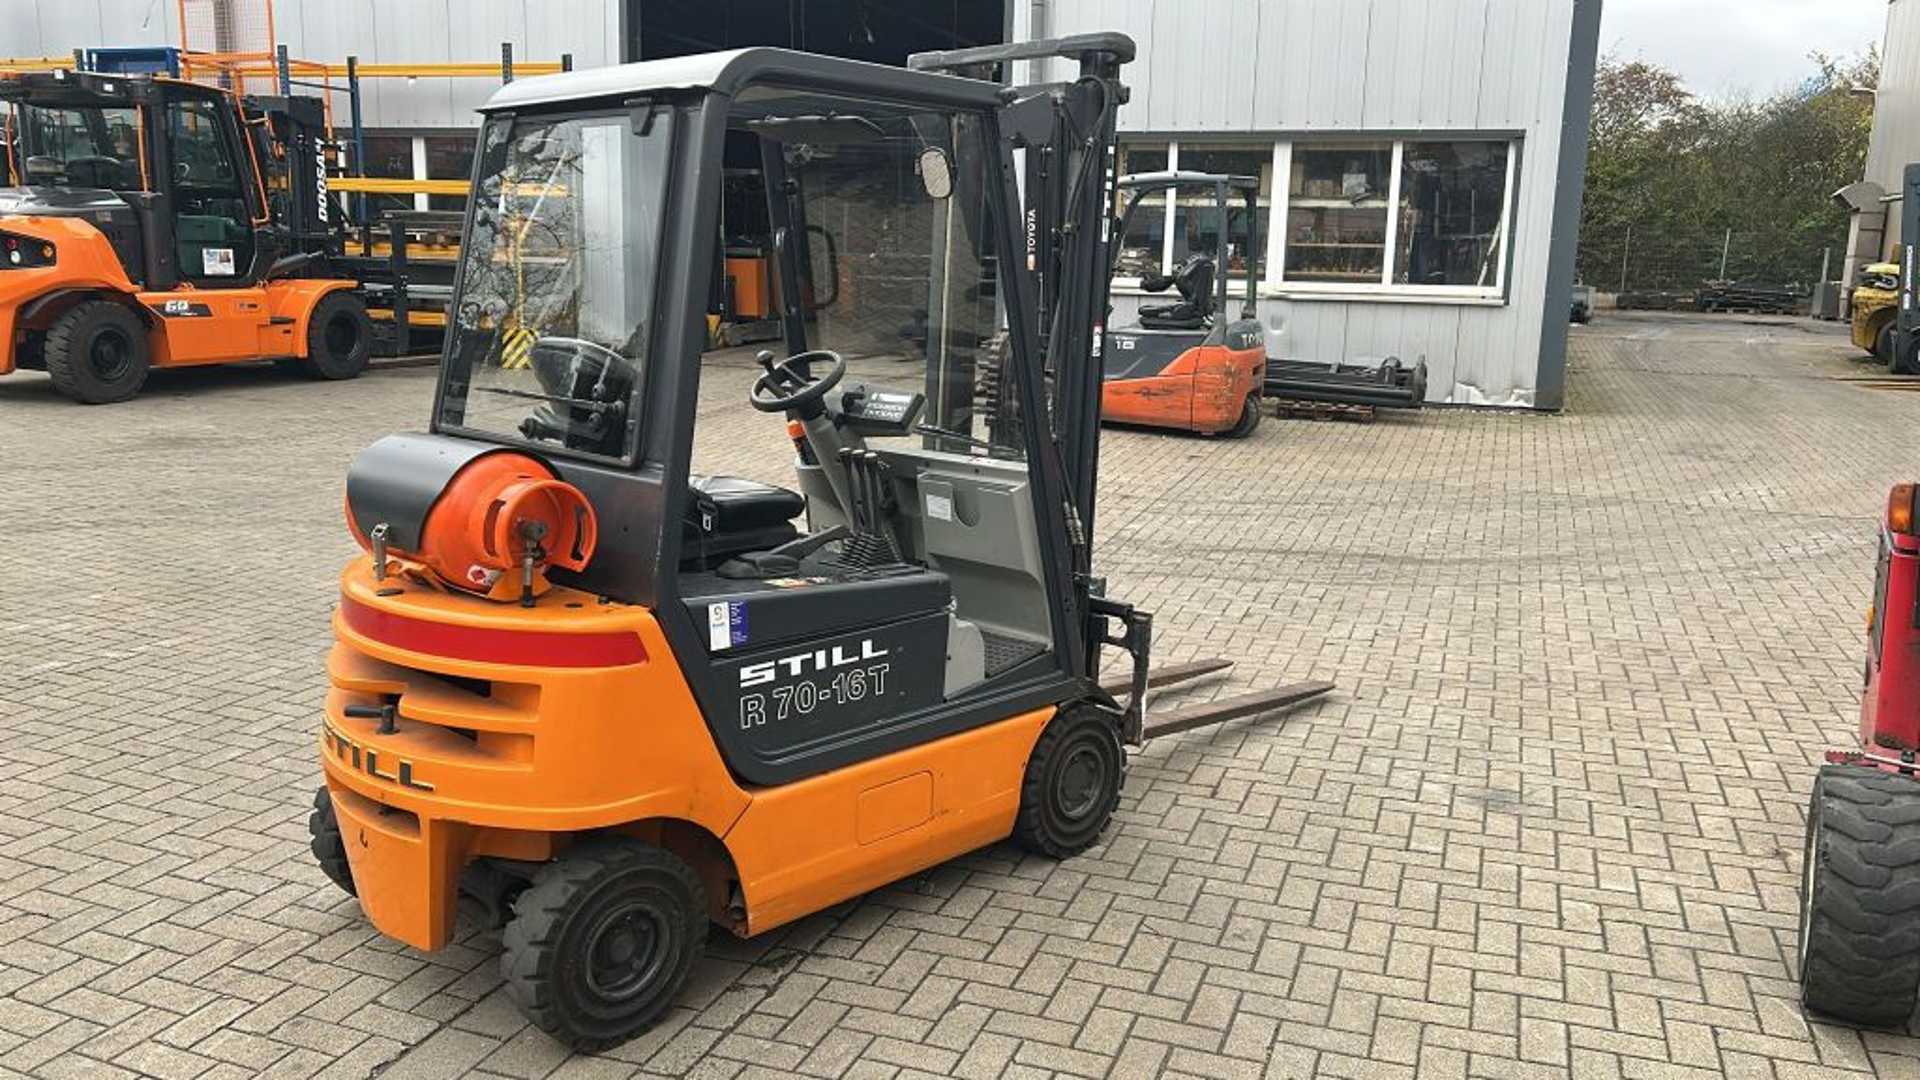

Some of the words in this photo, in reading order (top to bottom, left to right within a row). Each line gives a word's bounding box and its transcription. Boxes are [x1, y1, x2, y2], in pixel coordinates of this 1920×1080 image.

[314, 137, 328, 223] DOOSAN
[1026, 208, 1036, 253] TOYOTA
[740, 639, 888, 688] STILL
[740, 693, 766, 729] R
[772, 663, 890, 720] 70-16T
